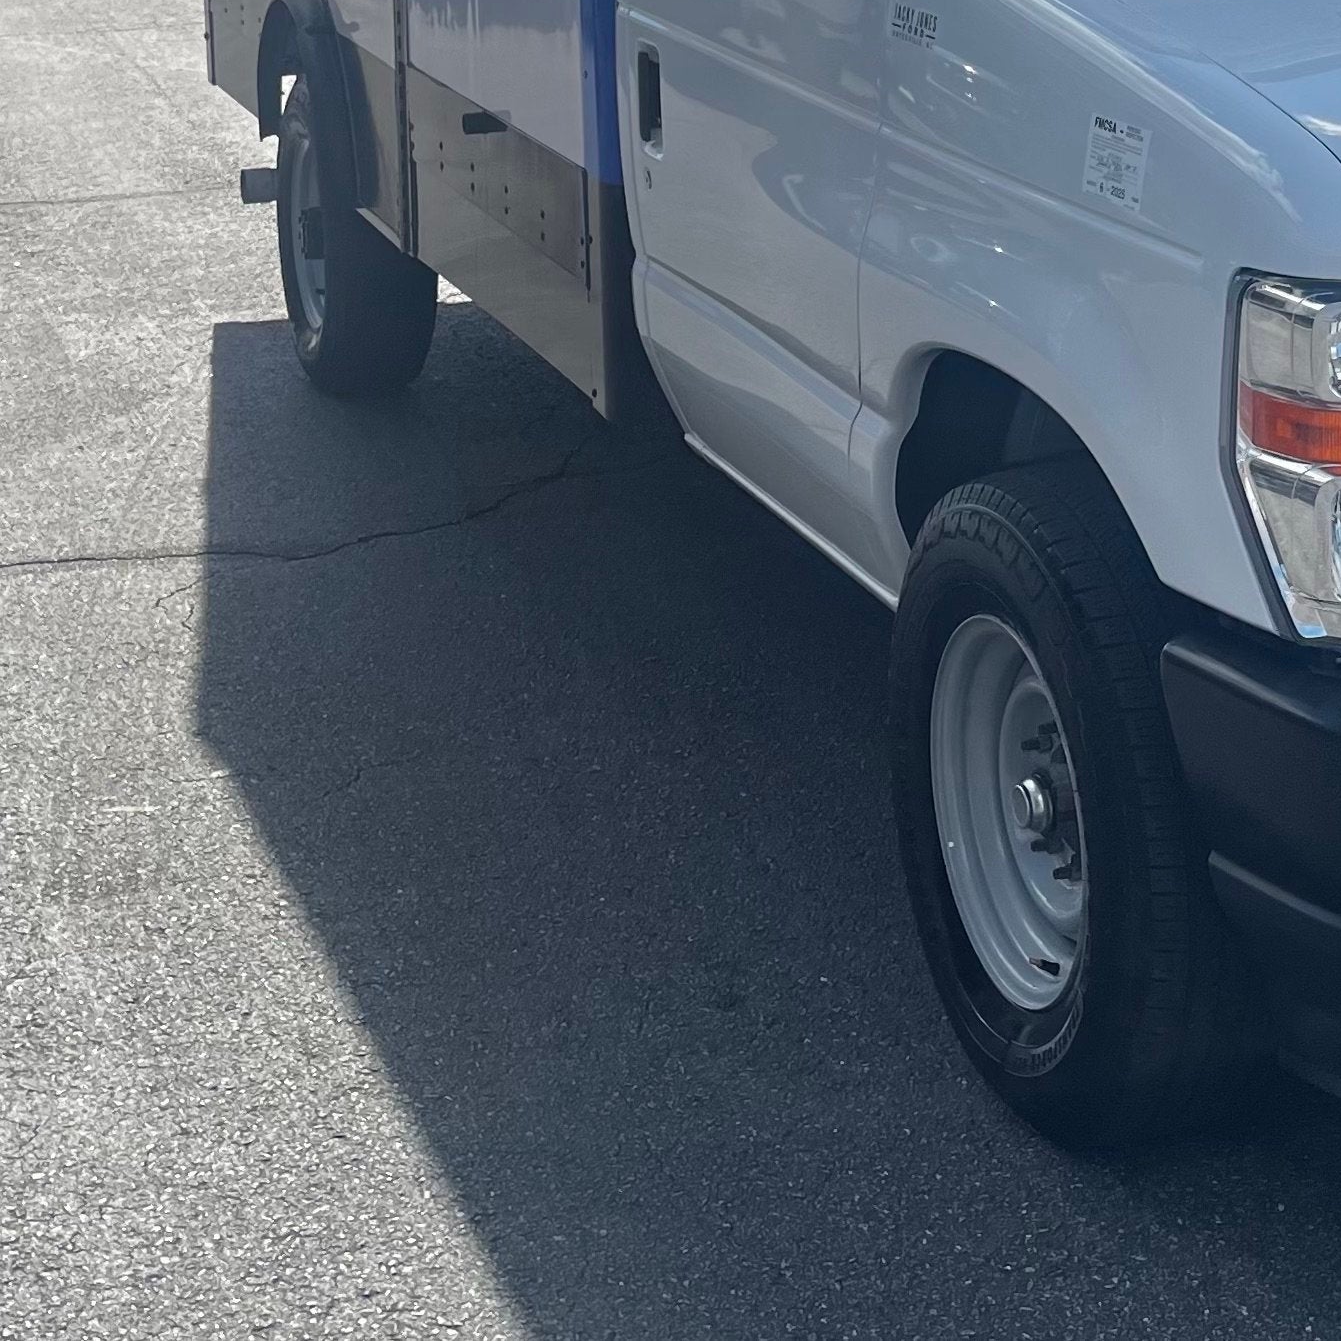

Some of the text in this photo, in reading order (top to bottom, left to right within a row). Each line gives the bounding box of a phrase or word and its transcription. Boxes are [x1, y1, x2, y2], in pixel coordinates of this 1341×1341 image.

[902, 22, 925, 39] FORD
[916, 10, 938, 33] JONES
[1094, 116, 1117, 135] FMCSA
